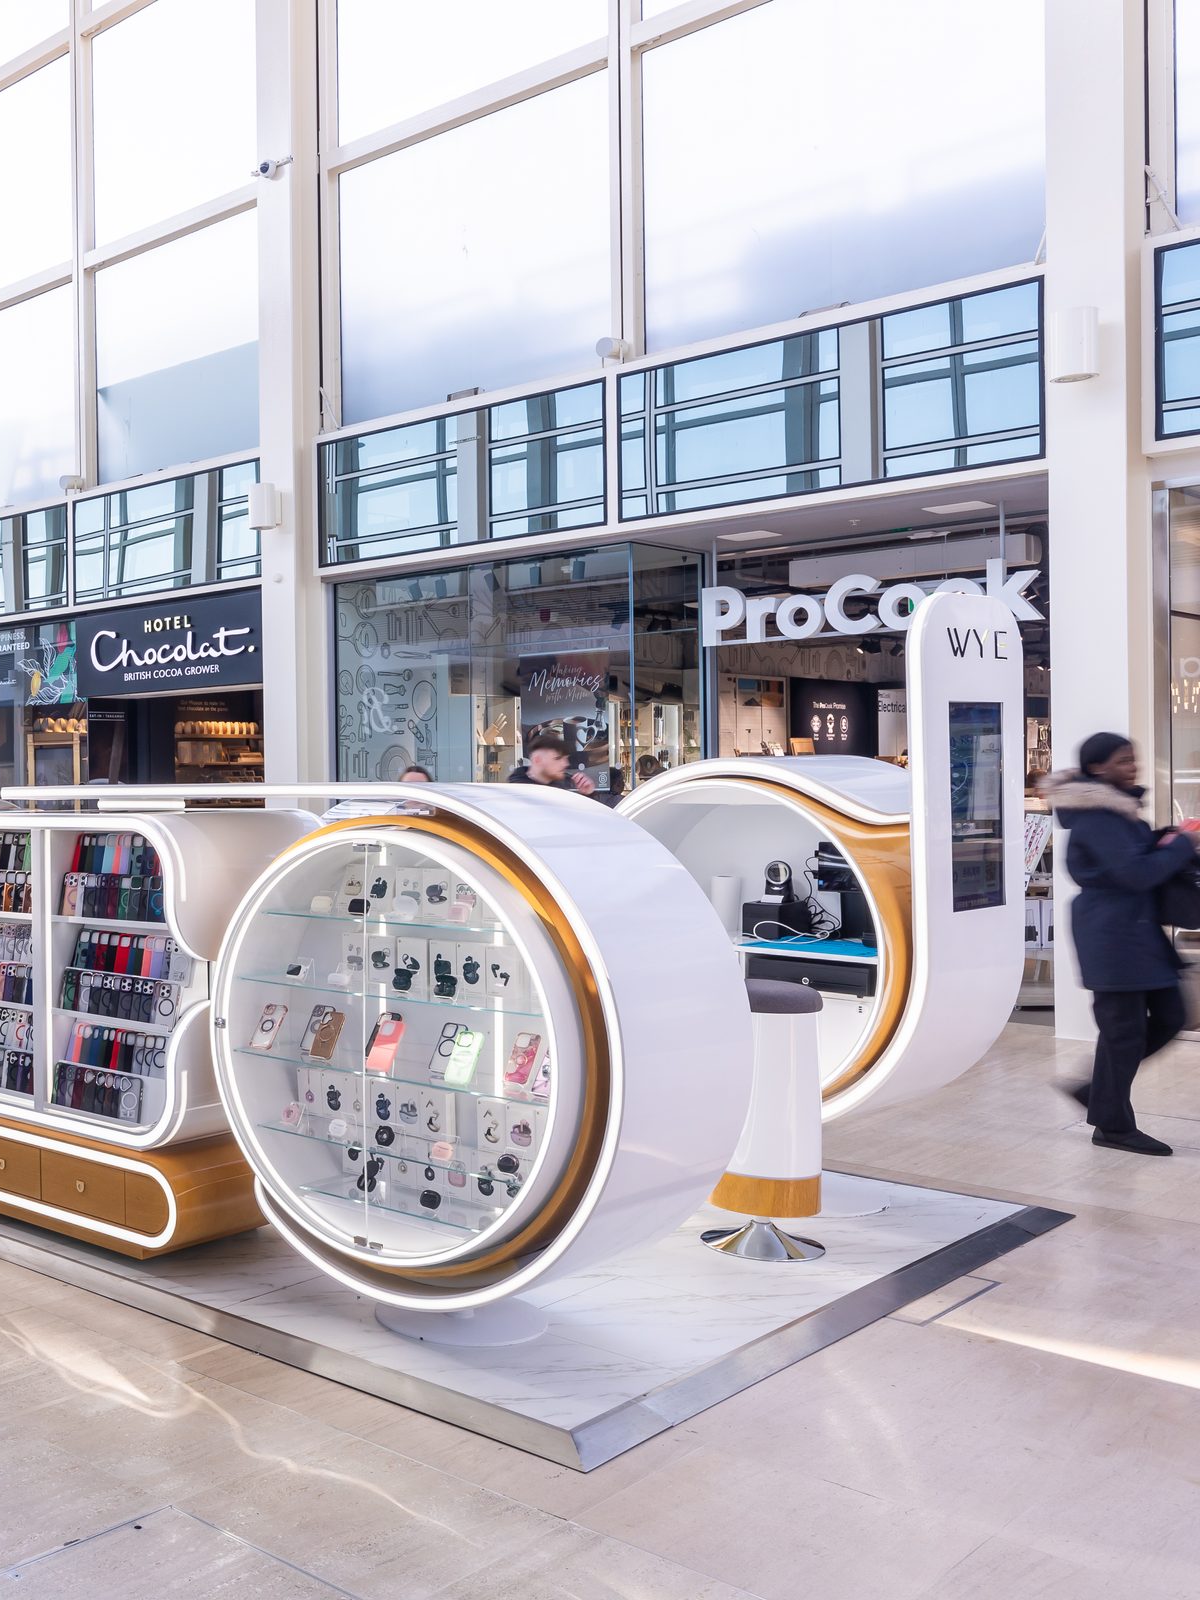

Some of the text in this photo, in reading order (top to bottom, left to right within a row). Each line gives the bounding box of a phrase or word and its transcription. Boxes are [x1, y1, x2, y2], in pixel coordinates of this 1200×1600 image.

[144, 615, 192, 633] HOTEL
[947, 627, 1008, 660] WYE
[124, 664, 220, 681] BRITISH COCOA GROWER
[528, 669, 602, 696] Memories
[878, 700, 906, 713] Electrica
